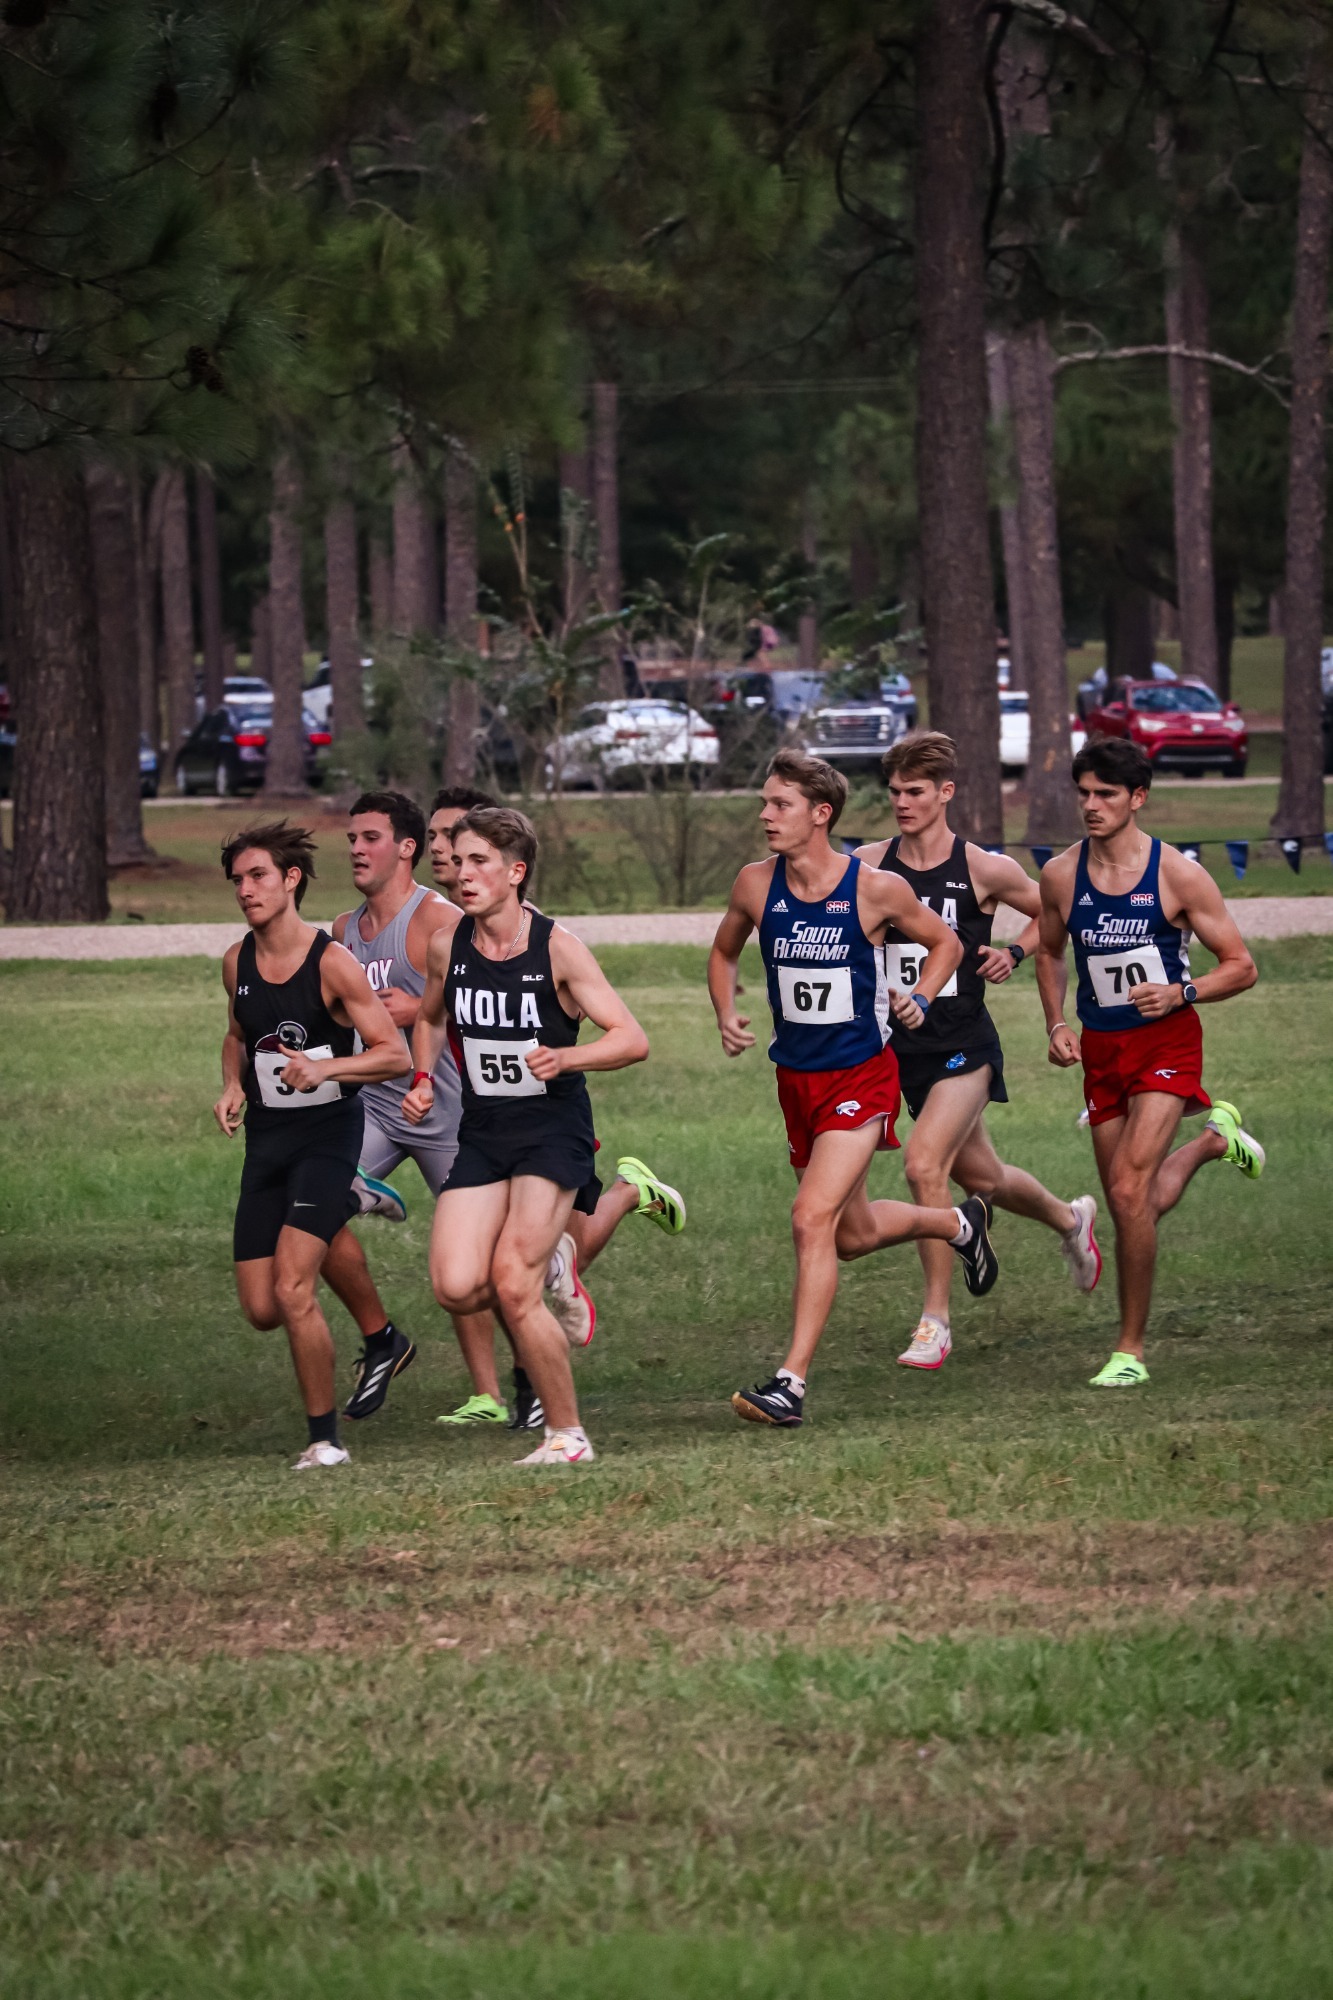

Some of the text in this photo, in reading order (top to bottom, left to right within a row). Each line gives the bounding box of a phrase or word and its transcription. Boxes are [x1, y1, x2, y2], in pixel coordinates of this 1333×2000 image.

[826, 900, 851, 914] SBC
[1130, 893, 1155, 907] SBC
[788, 920, 843, 944] SOUTH
[1095, 913, 1149, 935] SOUTH
[773, 937, 850, 960] ALABAMA
[360, 958, 393, 991] OY
[900, 956, 929, 986] 5
[1104, 962, 1148, 994] 70
[454, 987, 543, 1028] NOLA
[793, 981, 832, 1012] 67
[273, 1066, 319, 1096] 3
[480, 1053, 523, 1084] 55
